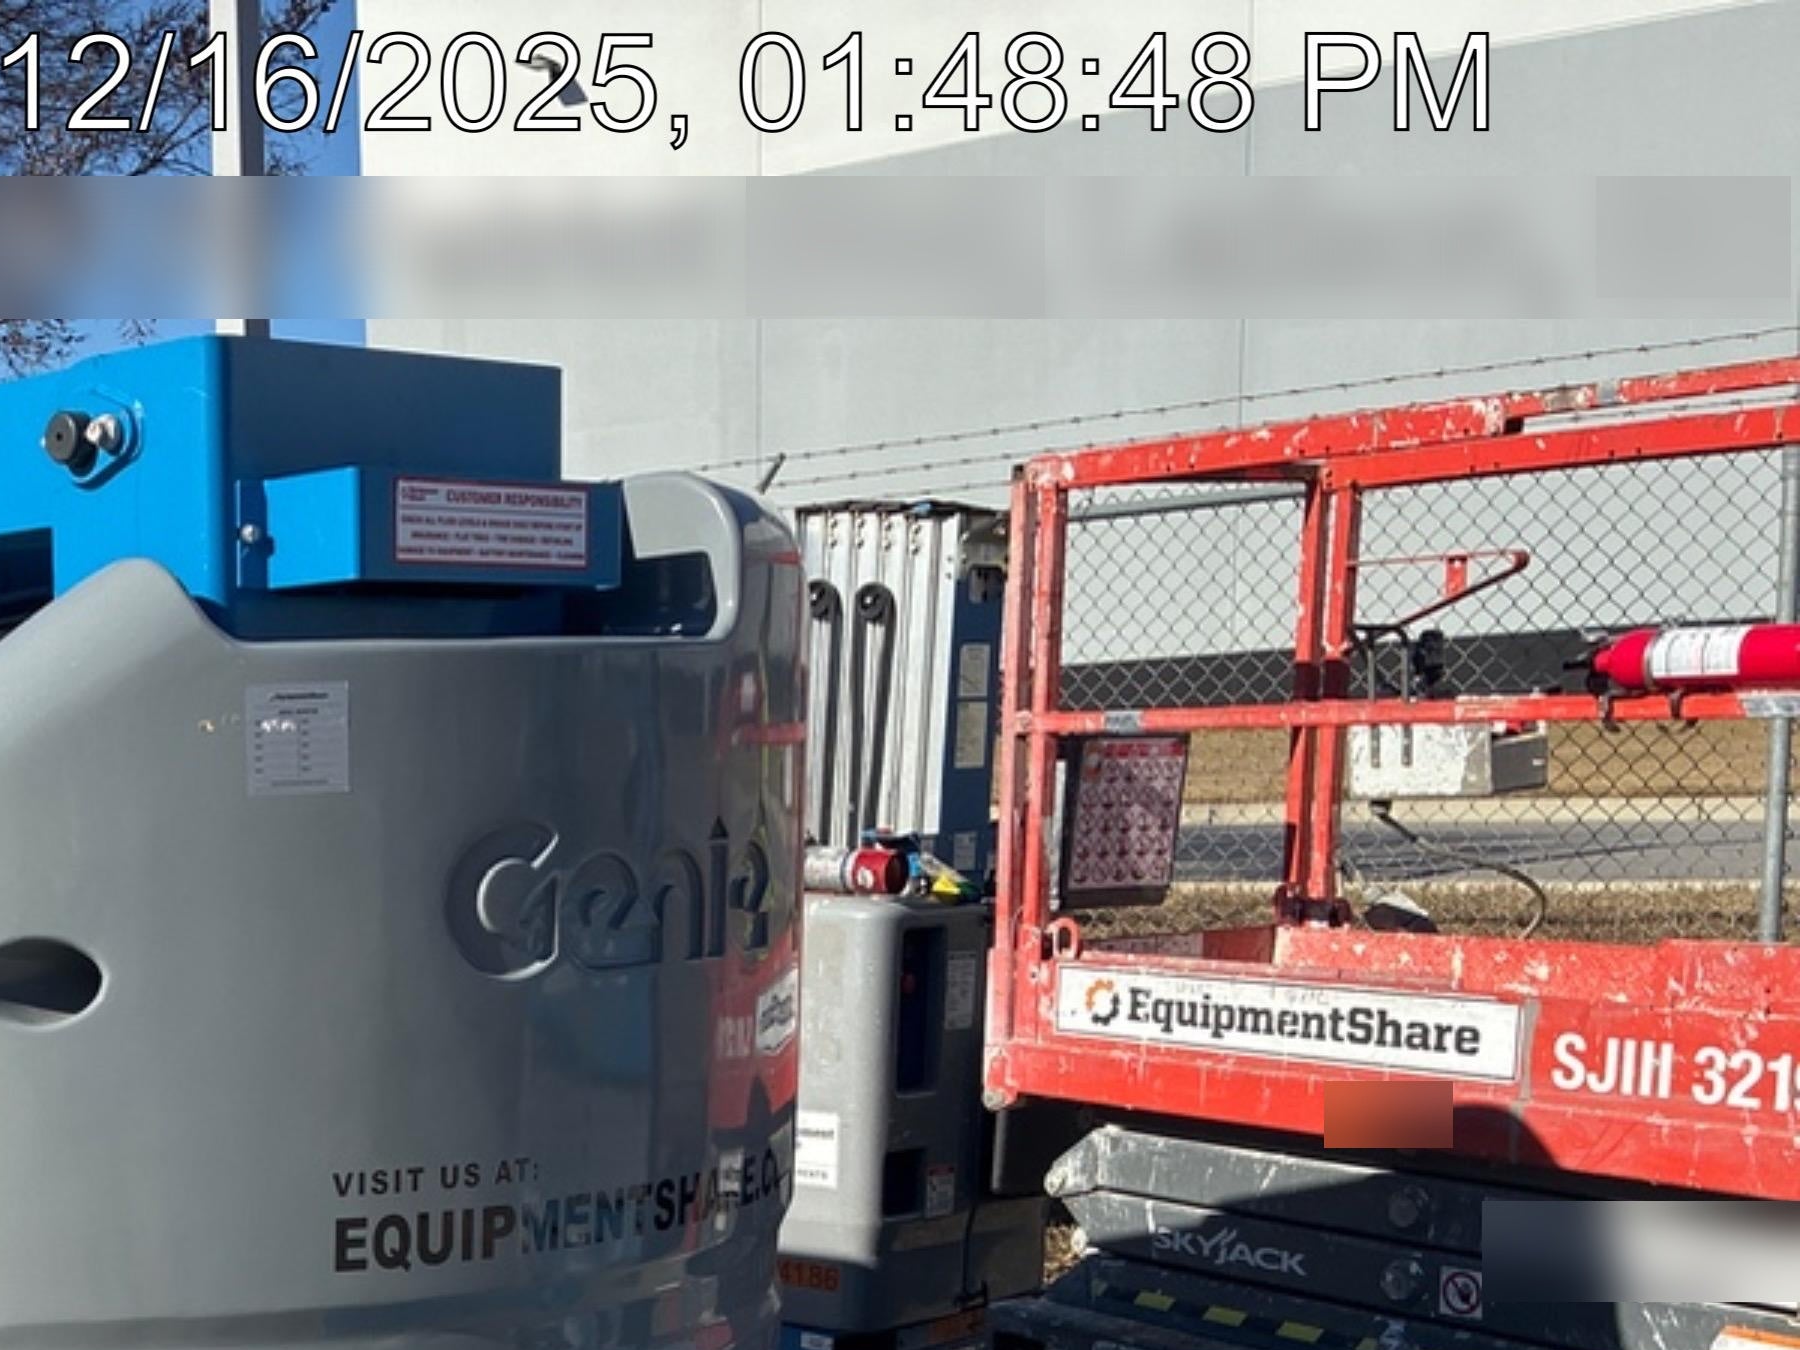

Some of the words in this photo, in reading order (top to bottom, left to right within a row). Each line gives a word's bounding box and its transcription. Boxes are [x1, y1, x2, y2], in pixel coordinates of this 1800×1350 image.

[1127, 987, 1481, 1057] EquipmentShare
[1691, 1045, 1800, 1113] 321
[332, 1167, 424, 1198] VISIT
[439, 1162, 480, 1189] US
[494, 1157, 539, 1186] AT:
[1153, 1227, 1307, 1276] SKYJACK
